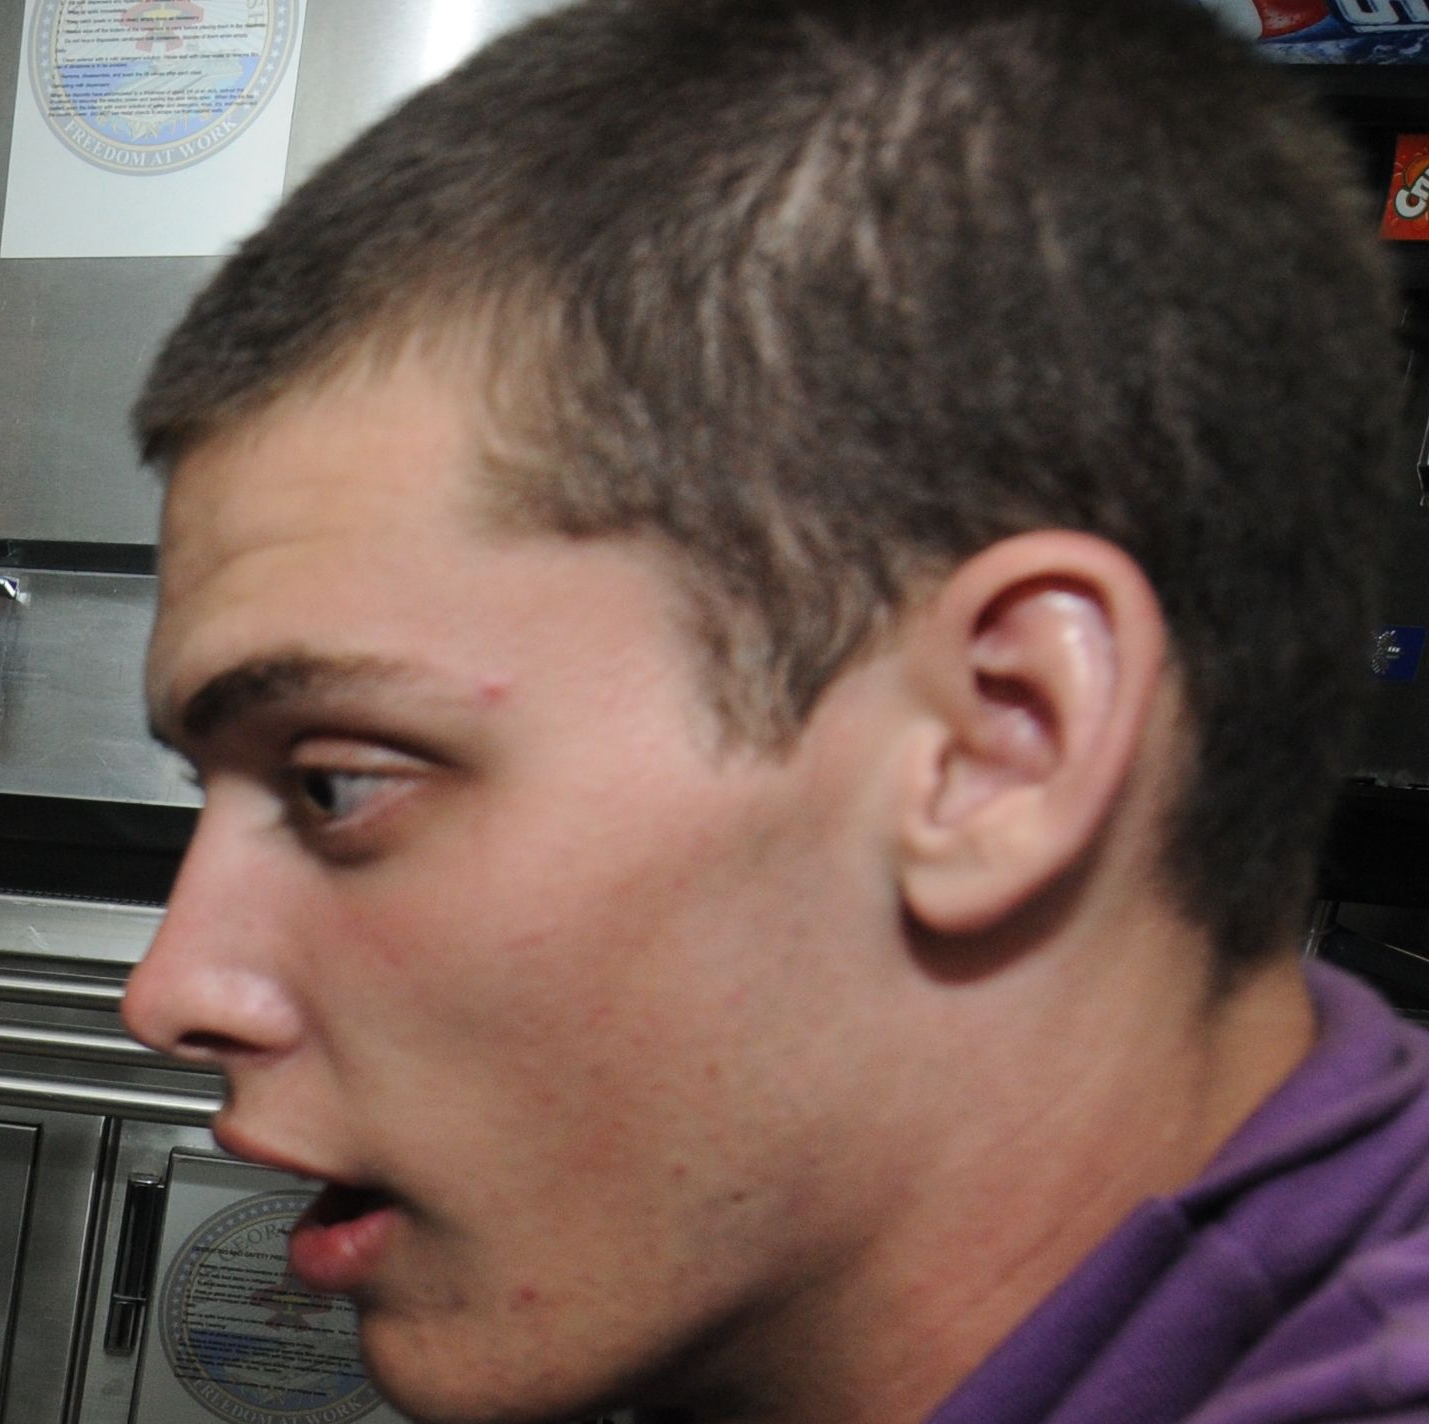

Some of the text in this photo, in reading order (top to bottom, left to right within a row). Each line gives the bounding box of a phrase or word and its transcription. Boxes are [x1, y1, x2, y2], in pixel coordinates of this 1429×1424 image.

[63, 119, 146, 167] FREEDOM
[150, 149, 174, 167] AT
[179, 117, 239, 159] WORK
